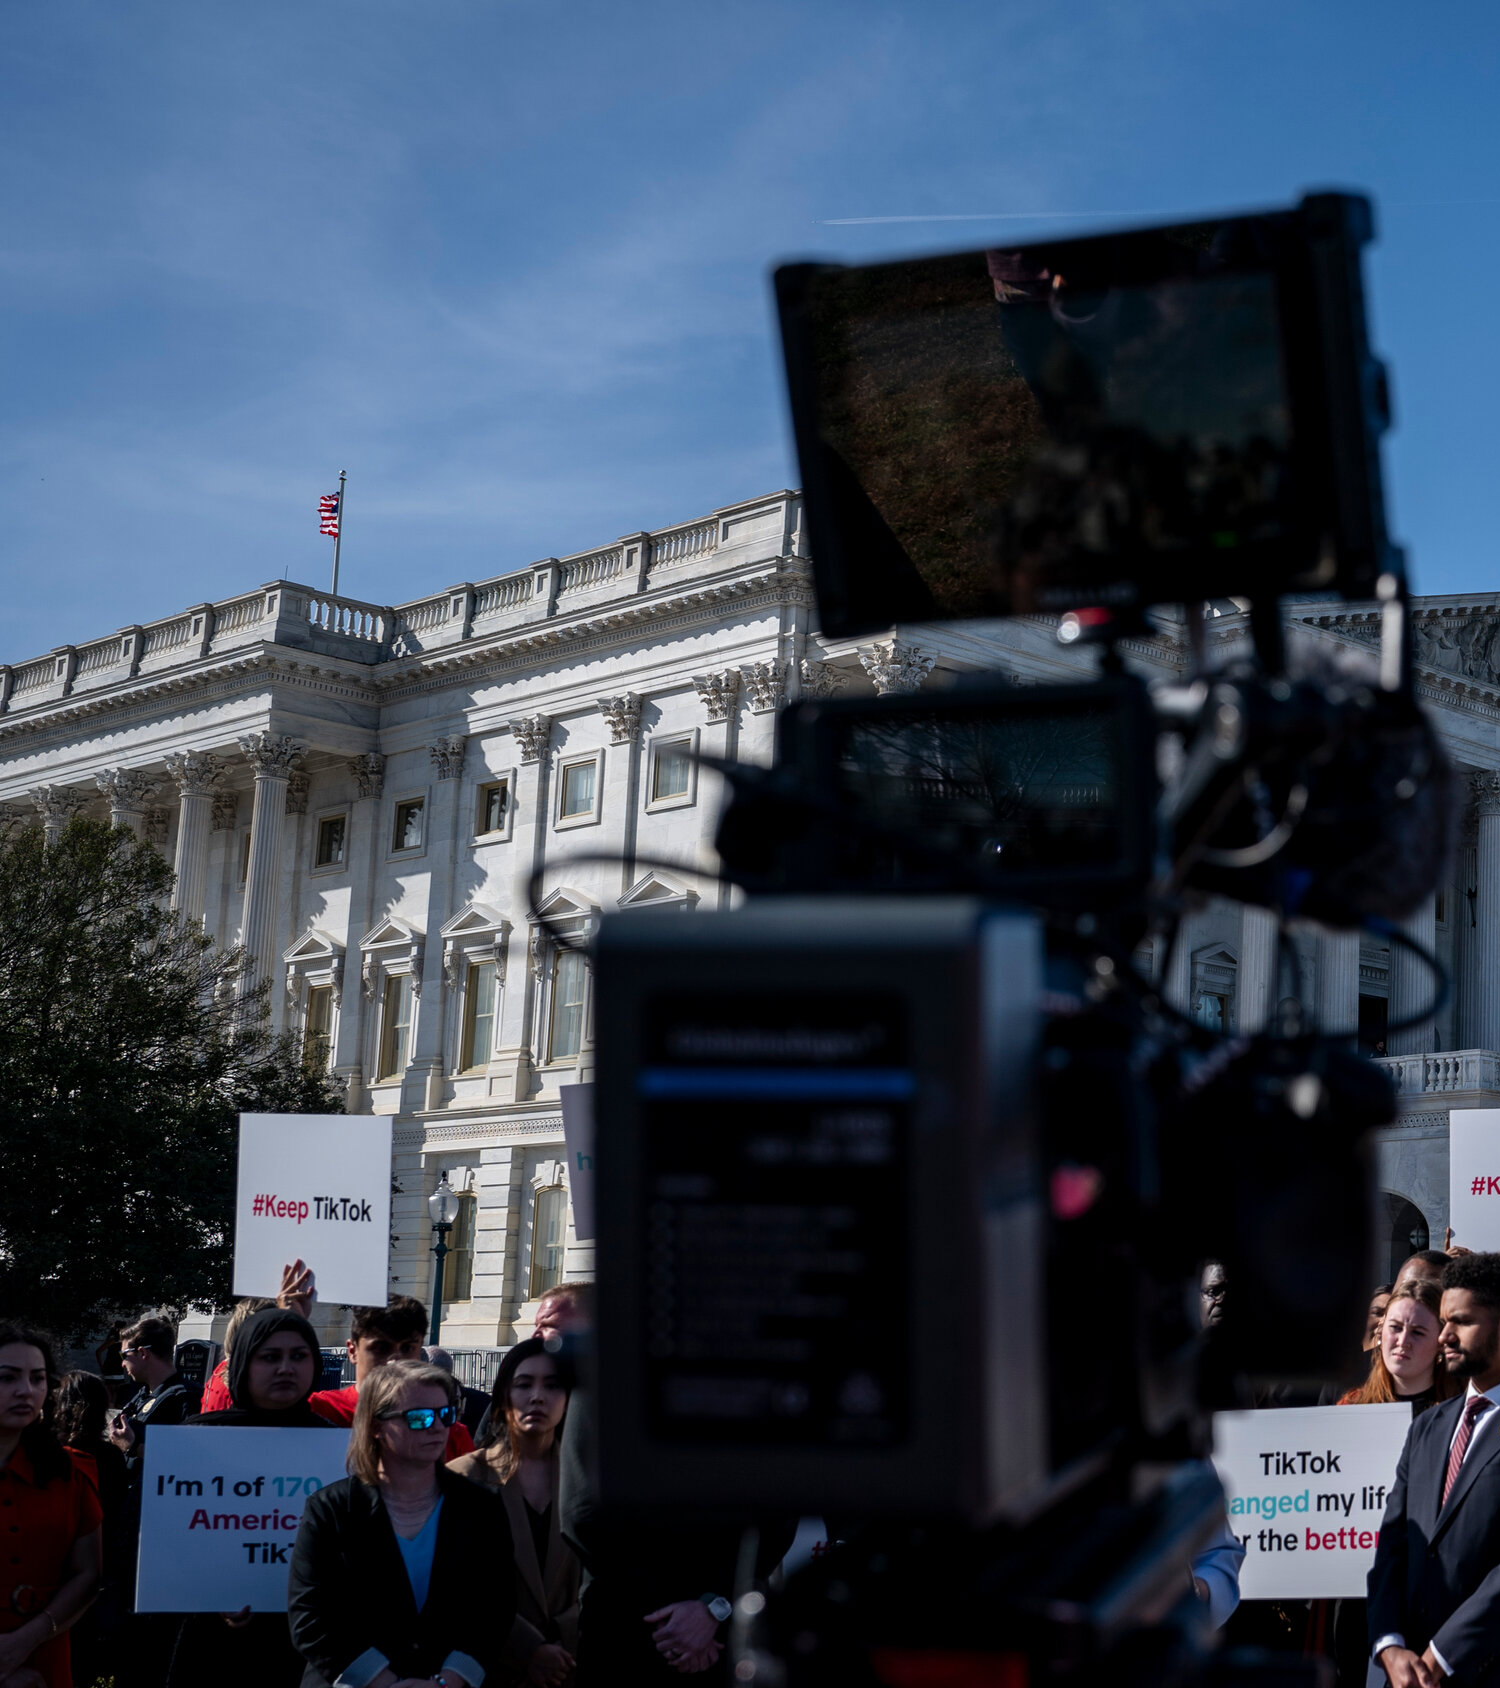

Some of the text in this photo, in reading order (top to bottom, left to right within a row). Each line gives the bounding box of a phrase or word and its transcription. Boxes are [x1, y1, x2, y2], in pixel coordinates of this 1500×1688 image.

[252, 1194, 372, 1225] #Keep TikTok
[1259, 1450, 1341, 1476] TikTok
[157, 1475, 323, 1497] I'm 1 of 170
[1226, 1485, 1389, 1520] anged my lif
[188, 1508, 304, 1530] Americ
[1257, 1528, 1299, 1552] the
[242, 1542, 295, 1564] Tik
